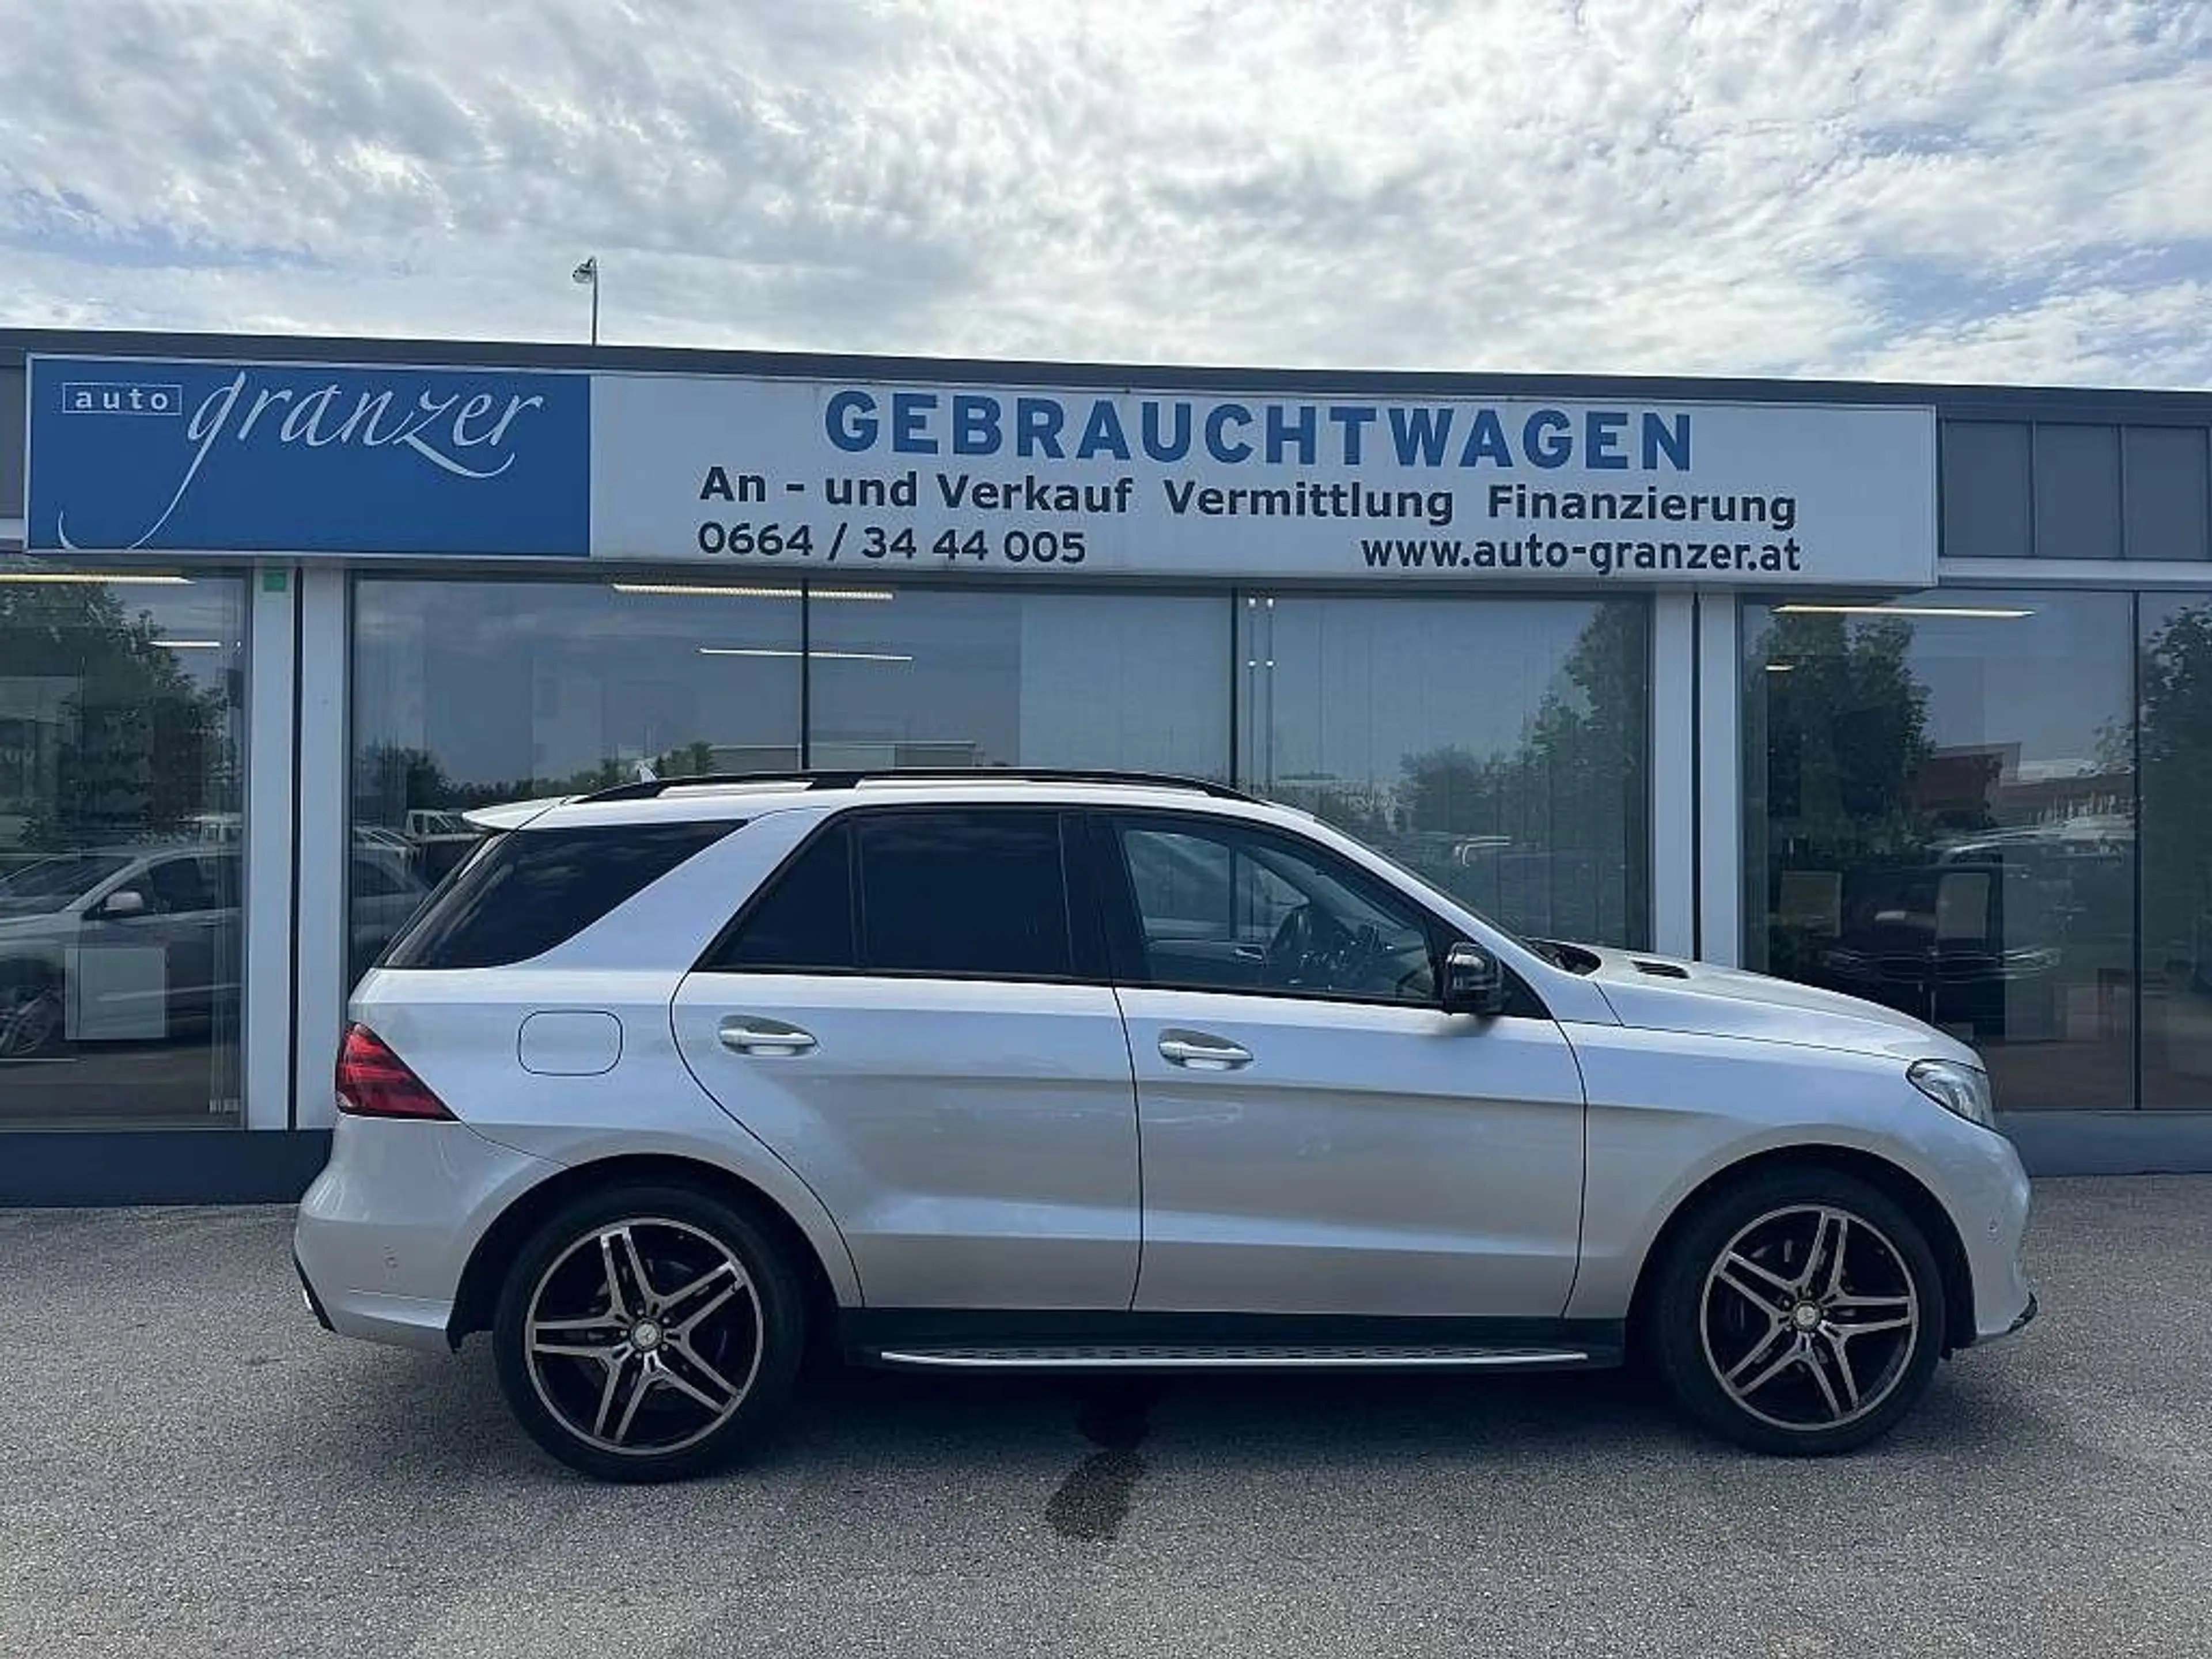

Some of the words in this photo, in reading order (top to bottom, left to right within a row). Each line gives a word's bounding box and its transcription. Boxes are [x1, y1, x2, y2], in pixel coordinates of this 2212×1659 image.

[75, 389, 171, 412] auto
[825, 390, 1691, 471] GEBRAUCHTWAGEN
[56, 370, 545, 550] granzer
[699, 465, 767, 503] An
[824, 472, 918, 507] und
[936, 474, 1132, 514] Verkauf
[1165, 480, 1454, 525] Vermittlung
[1488, 485, 1797, 530] Finanzierung
[698, 522, 813, 558] 0664
[862, 527, 917, 560] 34
[932, 528, 988, 561] 44
[1003, 531, 1086, 563] 005
[1361, 538, 1801, 575] www.auto-granzer.at
